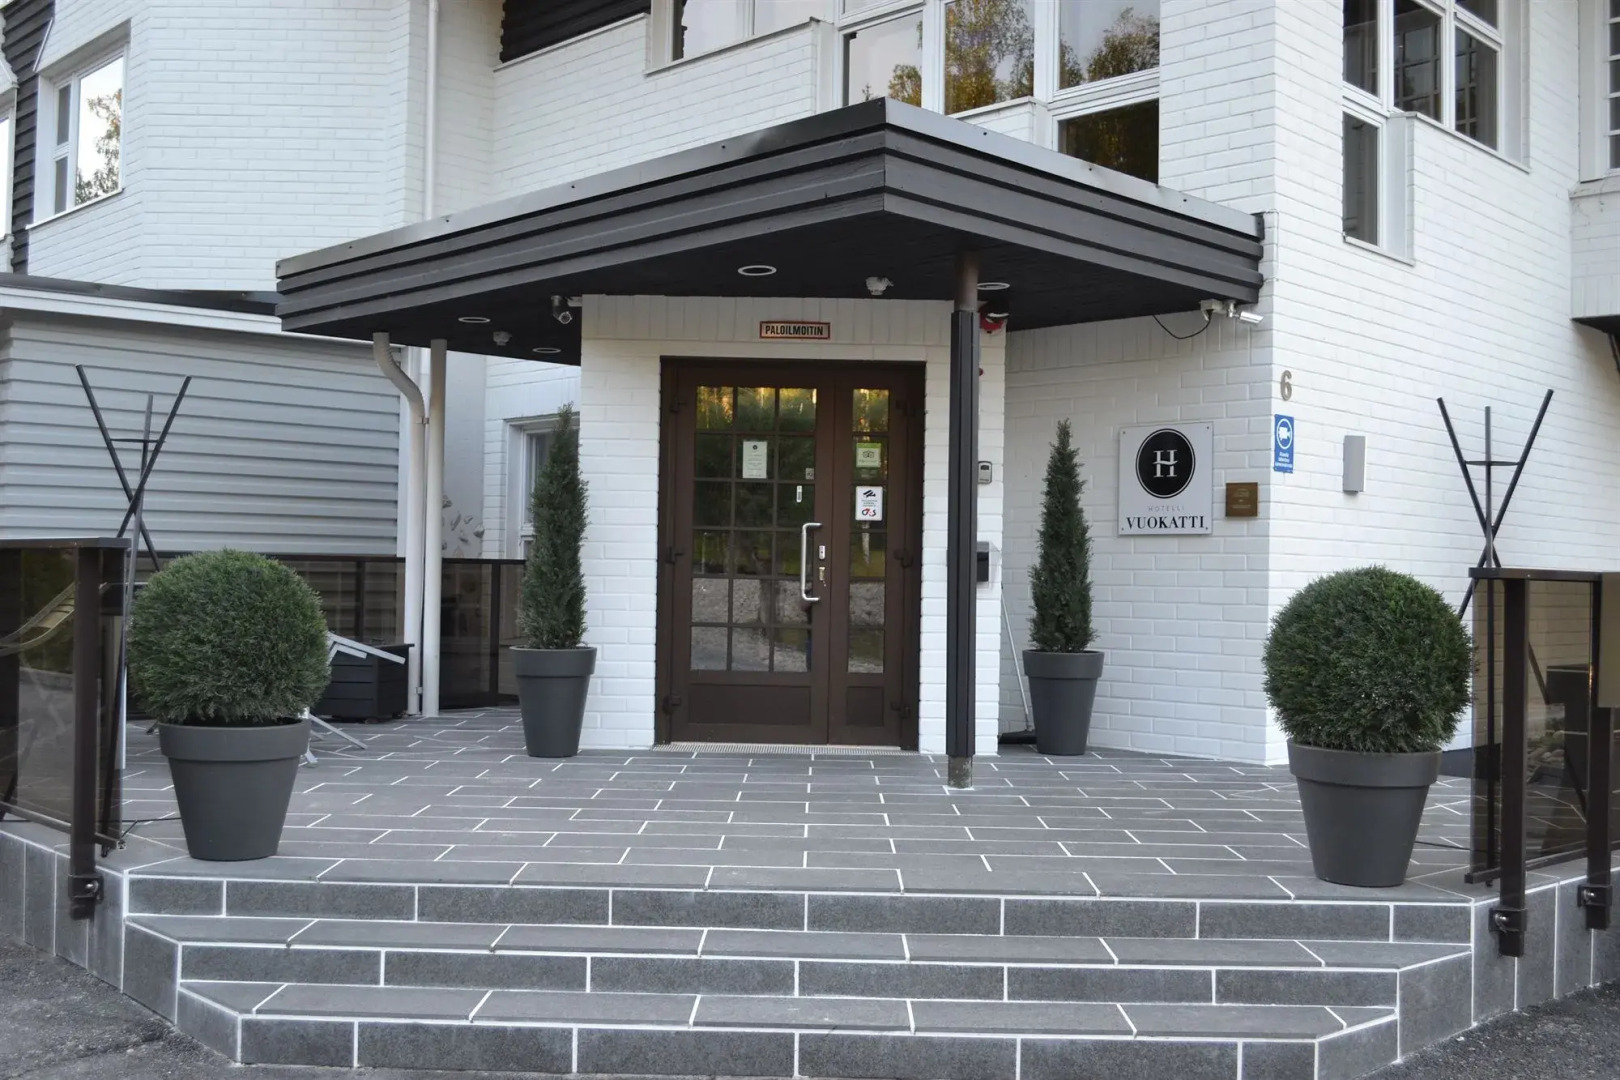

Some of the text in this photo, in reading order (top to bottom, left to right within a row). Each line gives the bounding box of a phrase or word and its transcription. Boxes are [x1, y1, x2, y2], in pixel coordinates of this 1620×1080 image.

[765, 325, 824, 336] PALOILMOITIN
[1280, 370, 1293, 402] 6
[1126, 515, 1205, 529] VUOKATTI
